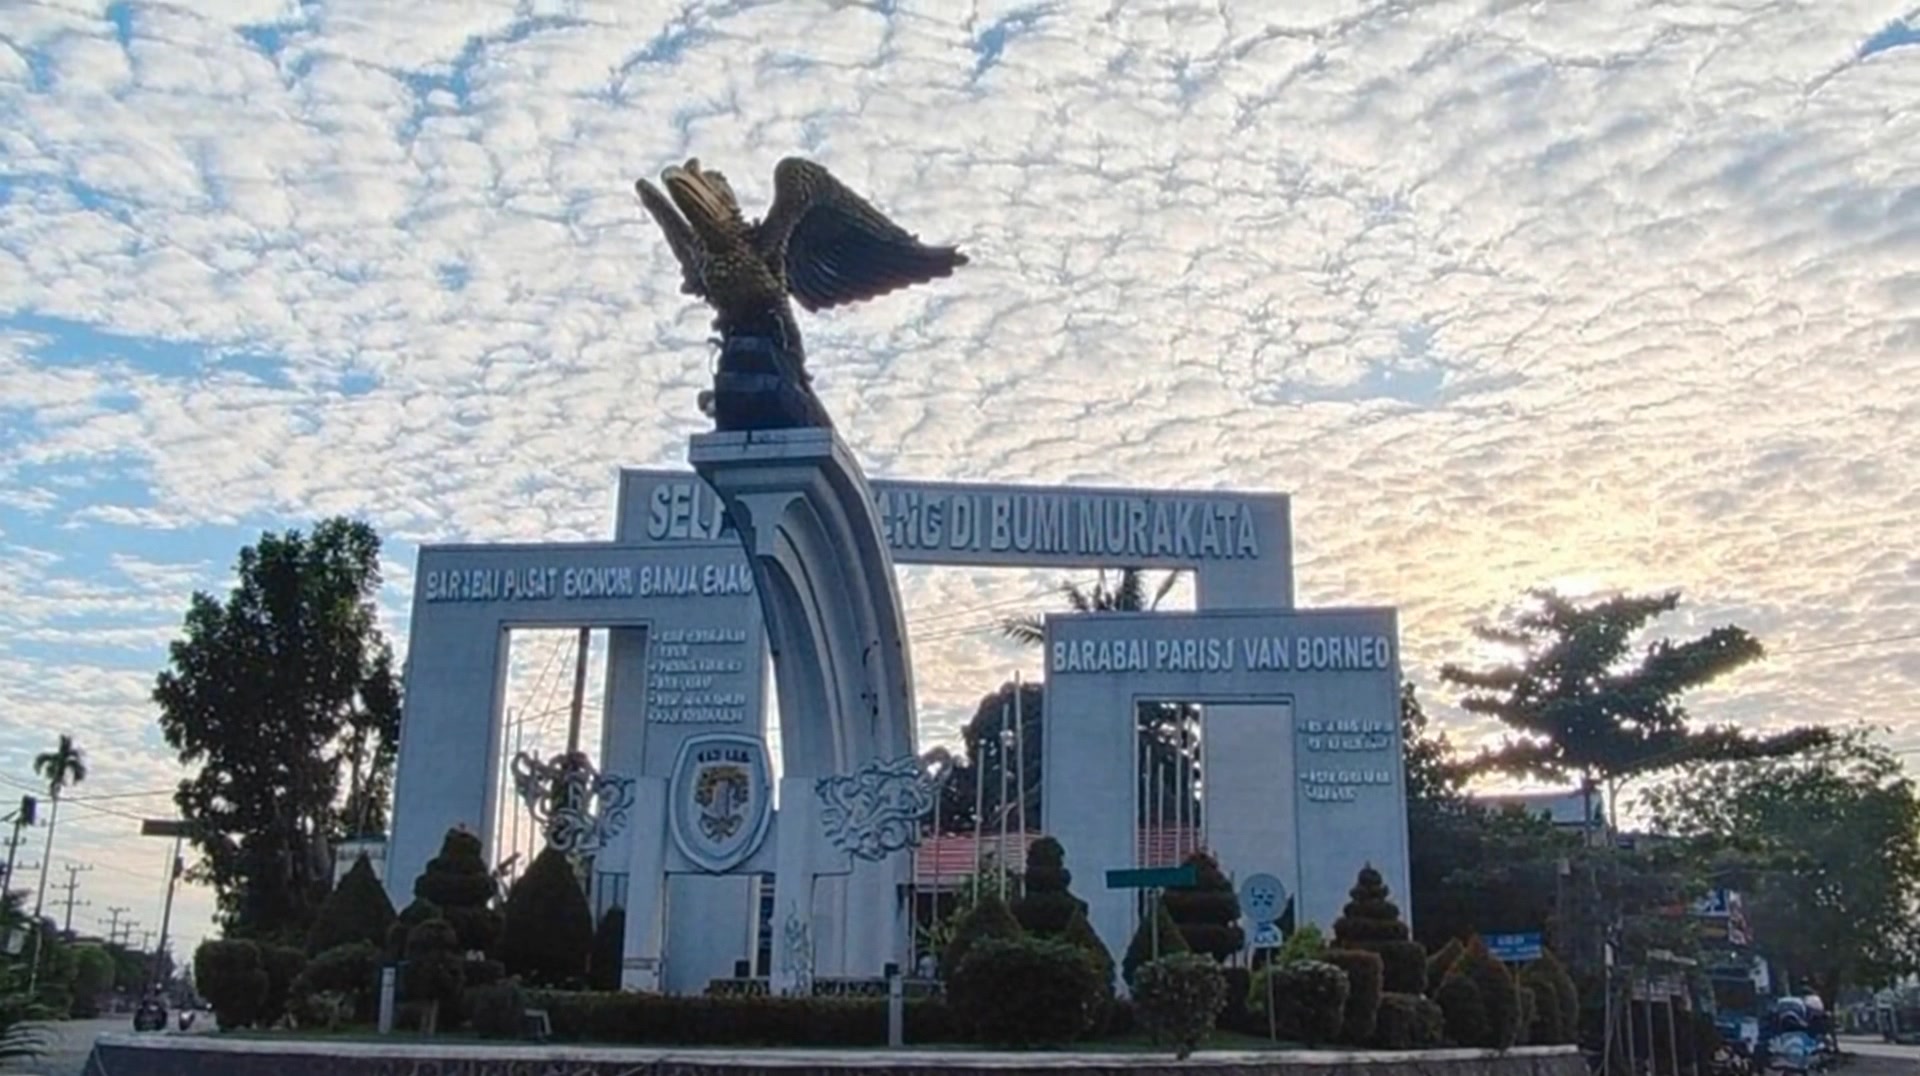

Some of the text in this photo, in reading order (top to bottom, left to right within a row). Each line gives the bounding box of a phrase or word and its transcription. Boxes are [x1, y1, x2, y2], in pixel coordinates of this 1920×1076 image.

[647, 483, 726, 541] SELA
[950, 494, 981, 550] DI
[990, 494, 1068, 553] BUMI
[1077, 496, 1258, 558] MURAKATA
[1053, 635, 1391, 672] BARABAI PARISJ VAN BORNEO
